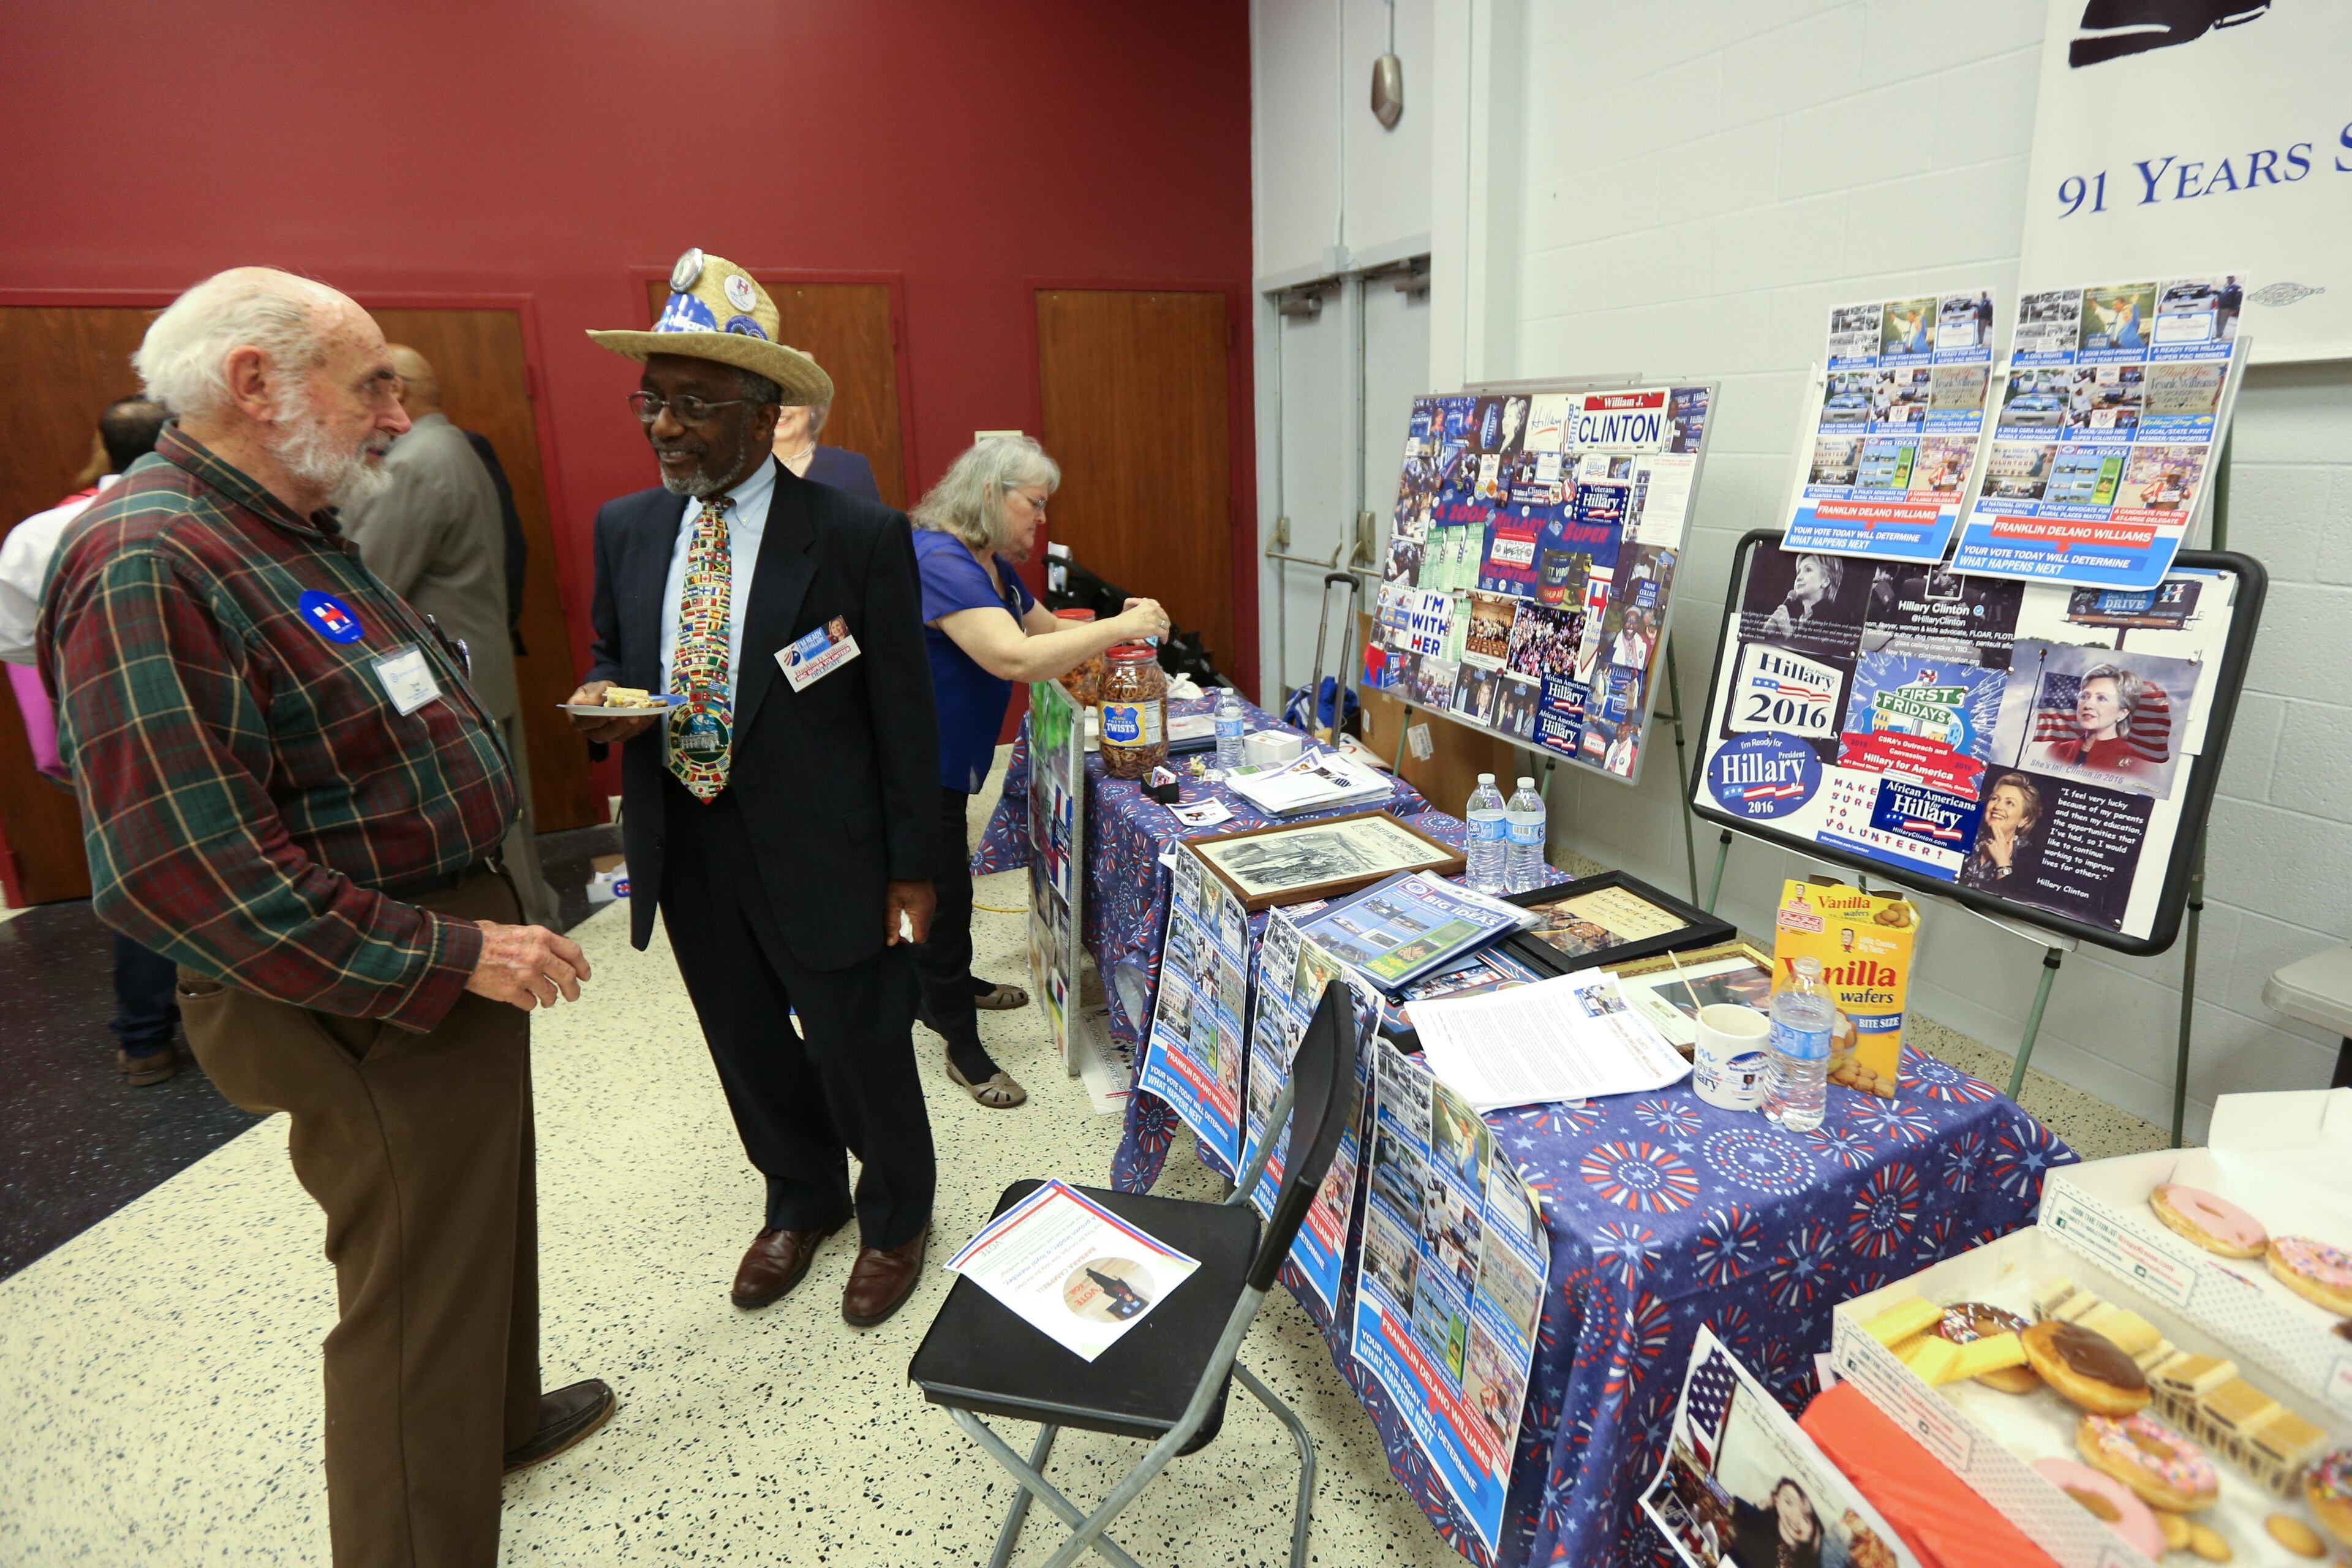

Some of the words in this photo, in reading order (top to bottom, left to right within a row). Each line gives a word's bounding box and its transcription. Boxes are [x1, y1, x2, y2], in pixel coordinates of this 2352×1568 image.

[2057, 170, 2107, 220] 91
[2132, 141, 2313, 207] YEARS
[1604, 397, 1635, 408] William
[1635, 396, 1644, 406] J.
[1532, 407, 1562, 437] Hillary
[1578, 413, 1661, 442] CLINTON
[1583, 493, 1619, 511] Hillary
[1817, 505, 1857, 516] FRANKLIN
[1858, 508, 1891, 517] DELANO
[1894, 510, 1937, 519] WILLIAMS
[1563, 521, 1610, 543] SUPER
[1790, 535, 1811, 545] WHAT
[1812, 538, 1849, 548] HAPPENS
[1849, 540, 1870, 550] NEXT
[1793, 526, 1813, 535] YOUR
[1814, 528, 1831, 537] VOTE
[1831, 529, 1856, 538] TODAY
[1875, 533, 1921, 543] DETERMINE
[1994, 522, 2048, 535] FRANKLIN
[2049, 526, 2092, 538] DELANO
[2094, 529, 2152, 542] WILLIAMS
[1961, 556, 1987, 567] WHAT
[1988, 559, 2034, 571] HAPPENS
[2034, 562, 2064, 575] NEXT
[1964, 545, 1989, 556] YOUR
[1989, 548, 2013, 558] VOTE
[2014, 549, 2046, 561] TODAY
[2046, 552, 2069, 564] WILL
[2071, 556, 2131, 569] DETERMINE
[1423, 594, 1445, 613] I'M
[1898, 600, 1930, 614] Hillary
[1932, 603, 1970, 616] Clinton
[1412, 612, 1446, 636] WITH
[1911, 614, 1966, 627] @HillaryClinton
[1411, 634, 1441, 656] HER
[807, 662, 824, 675] SUPER
[823, 647, 850, 665] VOLUNTEER
[1918, 654, 1980, 666] clintonfoundation.org
[1545, 673, 1562, 684] African
[1564, 680, 1589, 691] Americans
[1758, 651, 1835, 692] Hillary
[1815, 669, 1835, 680] President
[1548, 682, 1583, 707] Hillary
[1901, 689, 1954, 702] FIRST
[1548, 706, 1576, 718] HillaryClinton.com
[1744, 693, 1830, 729] 2016
[1882, 696, 1948, 723] FRIDAYS
[1106, 723, 1136, 733] TWISTS
[1741, 741, 1751, 750] I'm
[1752, 738, 1771, 747] Ready
[1879, 735, 1902, 746] CSRA's
[1902, 741, 1933, 752] Outreach
[1889, 748, 1927, 762] Canvassing
[1721, 753, 1806, 790] Hillary
[1863, 753, 1892, 769] Hillary
[1896, 760, 1910, 770] for
[1912, 764, 1954, 780] America
[2030, 759, 2050, 768] She's
[2065, 766, 2092, 779] Clinton
[2103, 774, 2124, 784] 2016
[1834, 778, 1877, 796] MAKE
[1887, 782, 1921, 797] African
[1923, 791, 1977, 812] Americans
[1748, 801, 1774, 813] 2016
[1831, 792, 1874, 810] SURE
[2058, 797, 2087, 811] because
[2100, 809, 2111, 818] my
[2113, 812, 2144, 824] parents
[2071, 790, 2087, 800] feel
[2089, 794, 2106, 805] very
[2108, 797, 2128, 810] lucky
[1830, 805, 1847, 817] TO
[1891, 794, 1962, 831] Hillary
[2056, 809, 2070, 818] and
[2071, 812, 2088, 821] then
[2103, 820, 2143, 836] education,
[1826, 819, 1943, 859] VOLUNTEER!
[1892, 826, 1948, 846] HillaryClinton.com
[2050, 828, 2065, 838] I've
[2068, 832, 2084, 843] had,
[2106, 843, 2127, 853] would
[2067, 822, 2116, 840] opportunities
[2119, 834, 2136, 845] that
[2047, 838, 2060, 846] like
[2073, 846, 2104, 859] continue
[2042, 858, 2059, 868] lives
[2060, 862, 2073, 871] for
[2075, 865, 2108, 881] others."
[2045, 849, 2072, 862] working
[2085, 859, 2115, 873] improve
[2037, 877, 2062, 892] Hillary
[2063, 885, 2089, 899] Clinton
[1422, 895, 1451, 911] BIG
[1452, 908, 1499, 928] IDEAS
[1818, 895, 1871, 909] Vanilla
[1780, 957, 1896, 987] Vnilla
[1840, 989, 1894, 1004] wafers
[1859, 1017, 1878, 1028] BITE
[1879, 1016, 1899, 1028] SIZE
[1068, 1283, 1085, 1295] FOR
[1360, 1341, 1384, 1368] WHAT
[1384, 1366, 1414, 1415] HAPPENS
[1414, 1411, 1434, 1445] NEXT
[1382, 1317, 1419, 1368] FRANKLIN
[1419, 1363, 1450, 1410] DELANO
[1450, 1404, 1491, 1469] WILLIAMS
[1361, 1330, 1381, 1354] YOUR
[1383, 1351, 1400, 1376] VOTE
[1400, 1373, 1421, 1406] TODAY
[1421, 1401, 1436, 1431] WILL
[1438, 1428, 1477, 1493] DETERMINE
